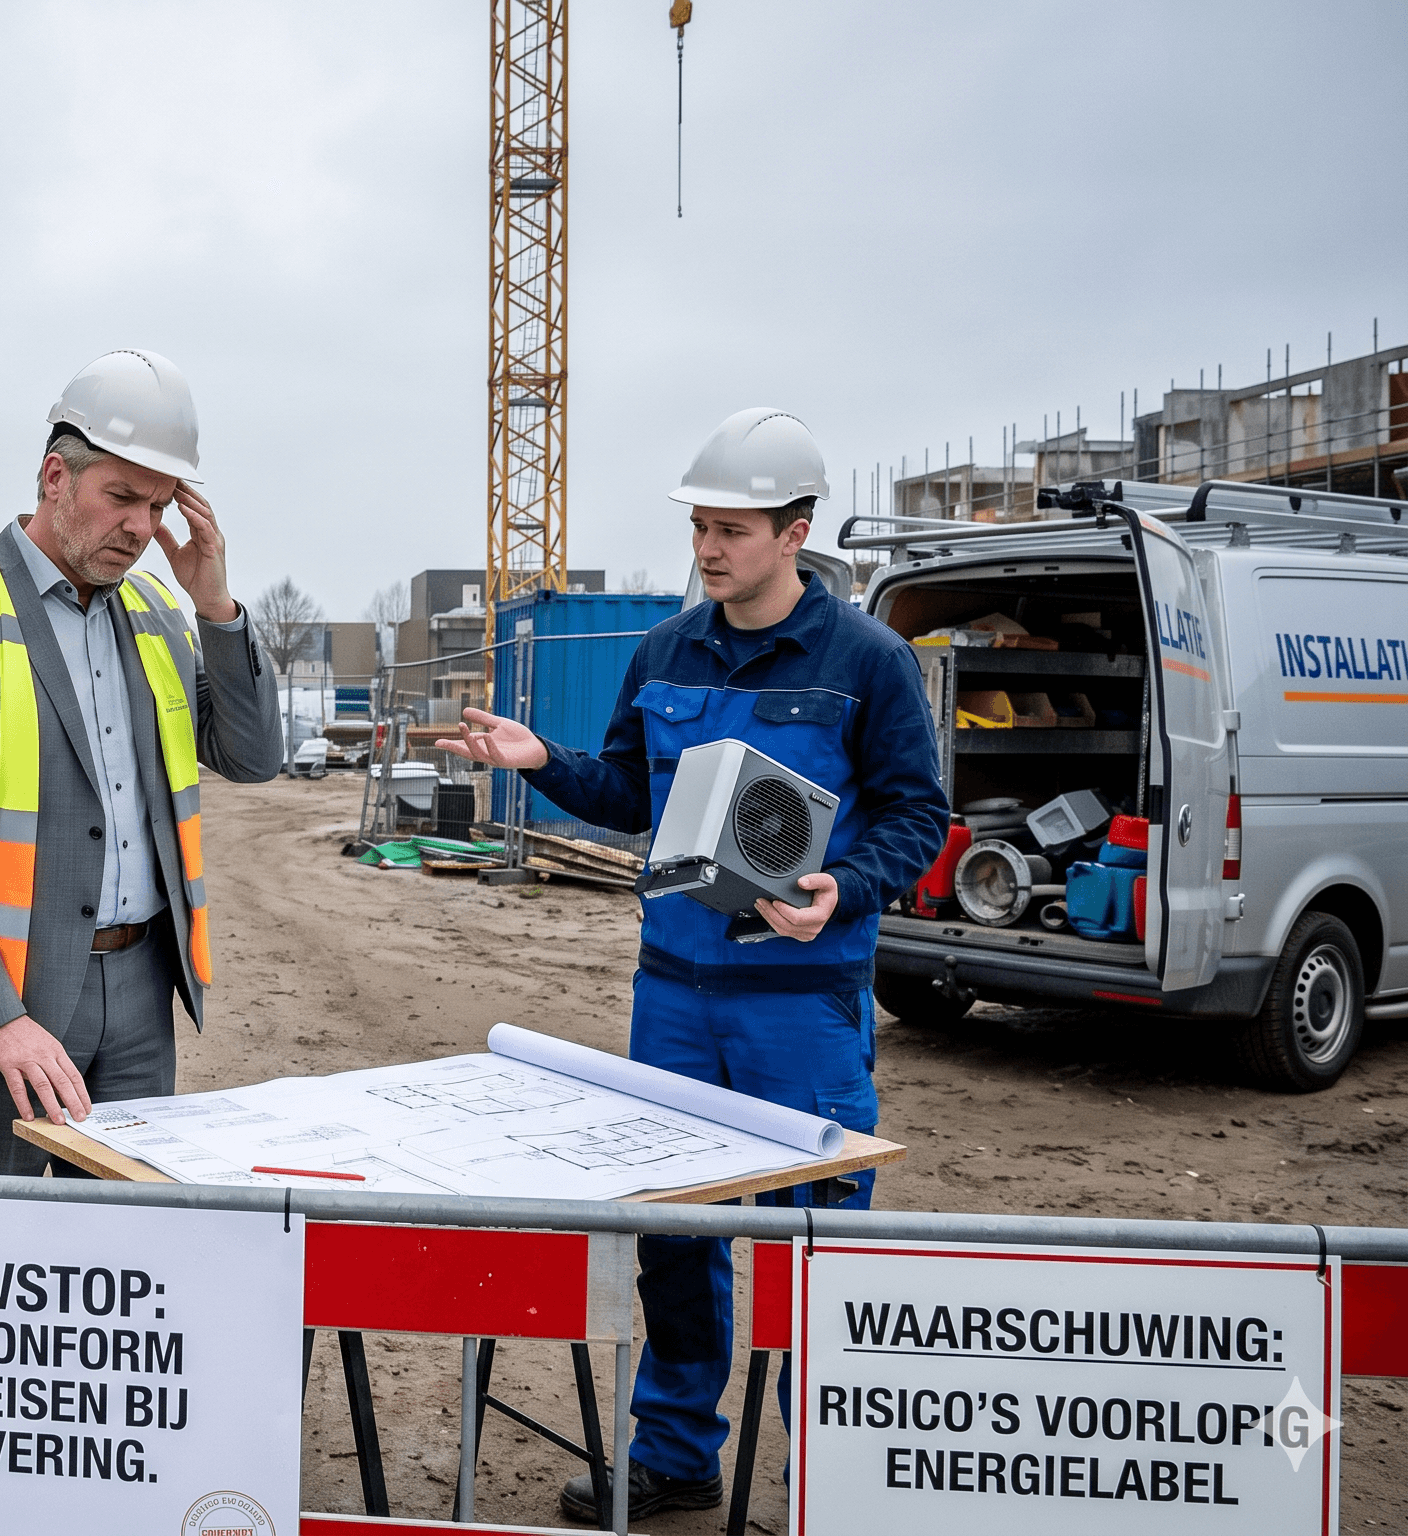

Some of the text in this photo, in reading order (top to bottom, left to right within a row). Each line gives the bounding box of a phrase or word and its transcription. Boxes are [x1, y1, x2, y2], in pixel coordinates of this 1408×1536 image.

[1275, 632, 1408, 681] INSTALLATI
[844, 1301, 1284, 1364] WAARSCHUWING:
[125, 1384, 188, 1431] BIJ
[819, 1384, 1309, 1449] RISICO’S VOORLOPIG
[886, 1447, 1239, 1506] ENERGIELABEL
